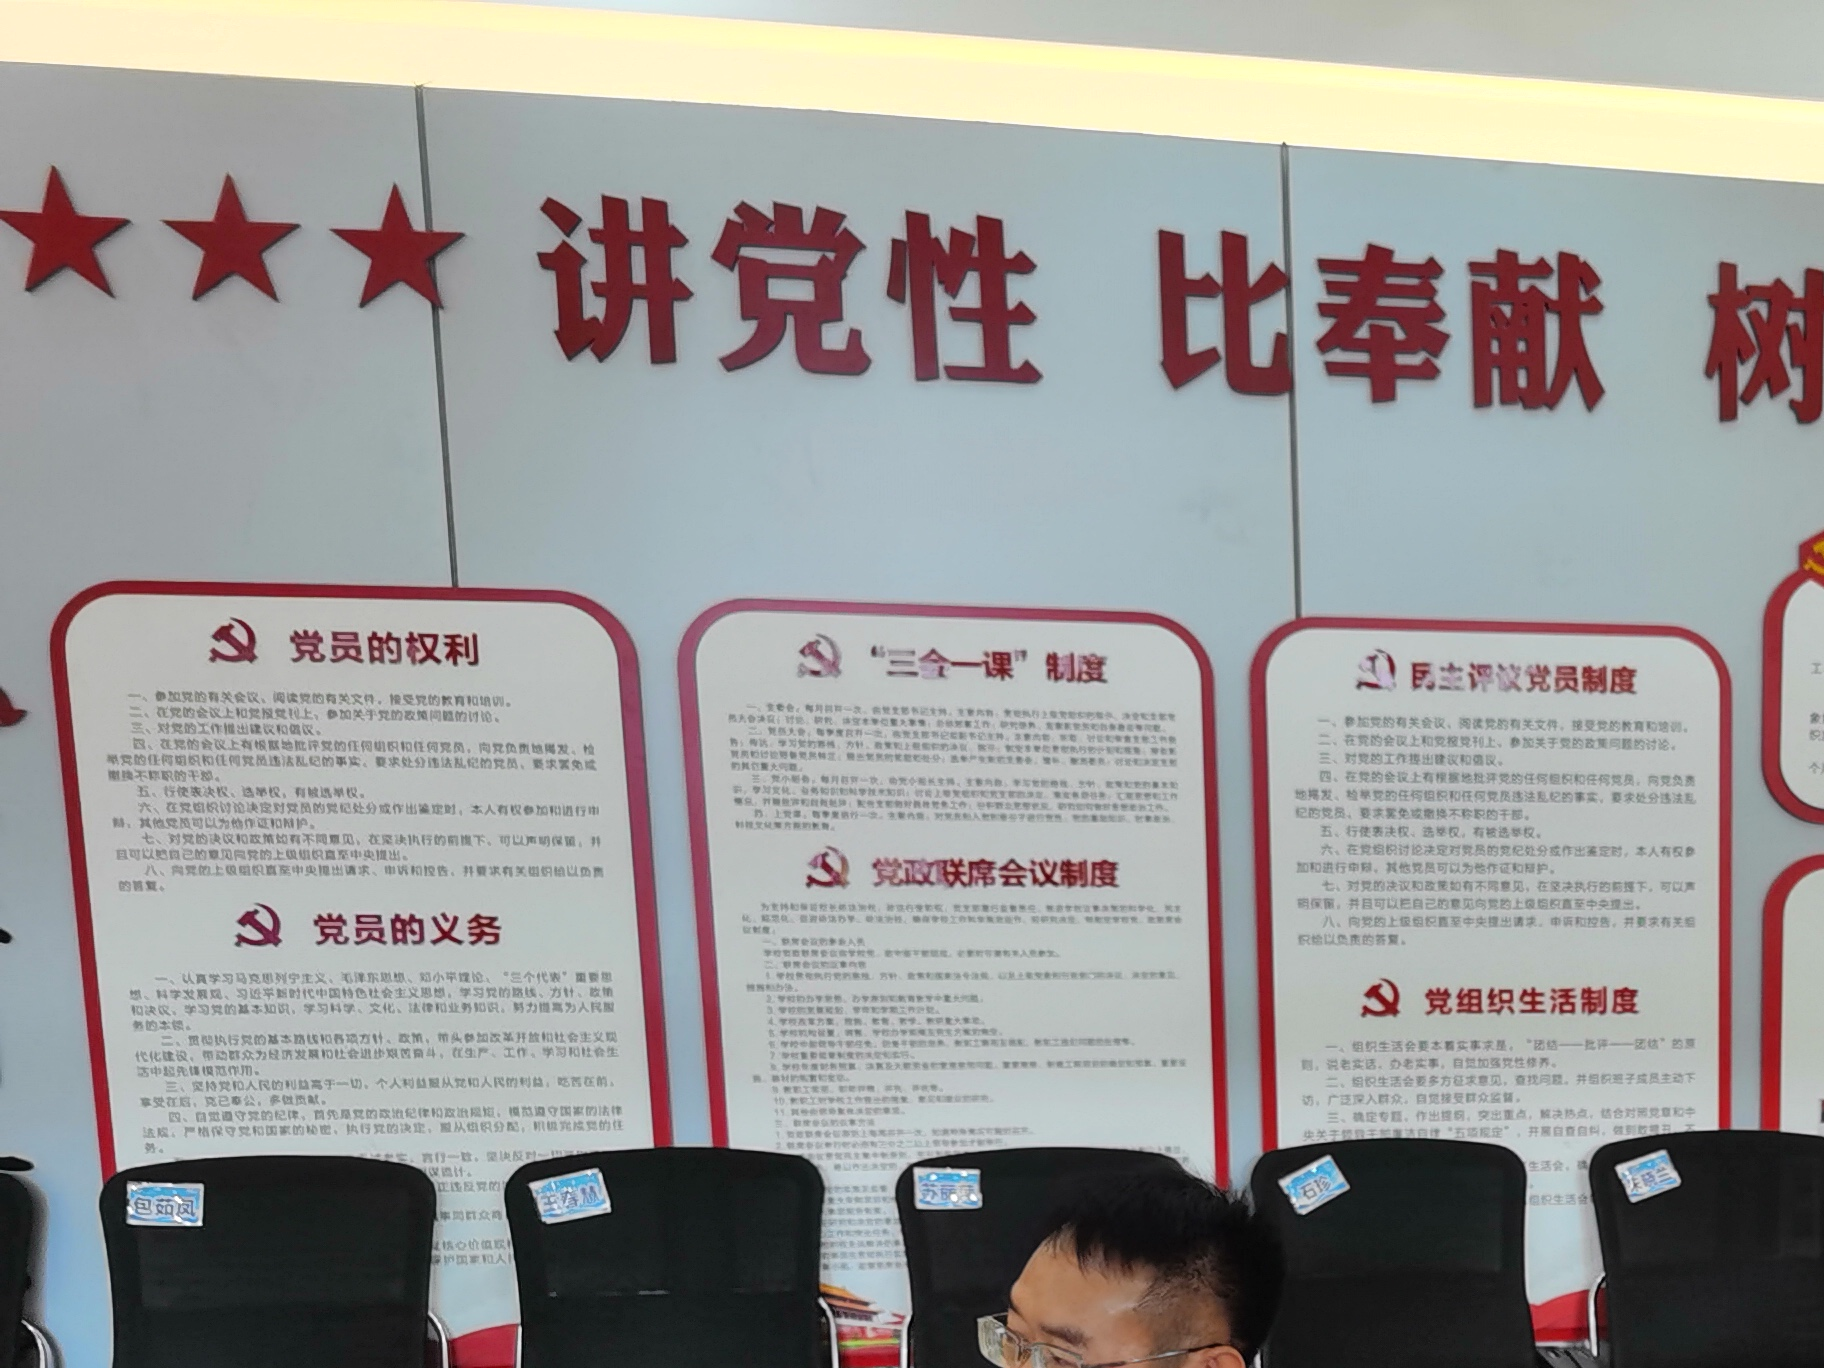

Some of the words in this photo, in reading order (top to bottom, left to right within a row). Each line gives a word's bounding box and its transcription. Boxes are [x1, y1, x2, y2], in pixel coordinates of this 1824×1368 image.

[535, 193, 1043, 385] 讲党性
[1157, 229, 1605, 412] 比奉献
[289, 629, 480, 667] 党员的权利
[1410, 661, 1638, 695] 民主评议党员制度
[872, 857, 1121, 889] 党政联席会议制度
[313, 912, 502, 947] 党员的义务
[1424, 986, 1640, 1017] 党组织生活制度
